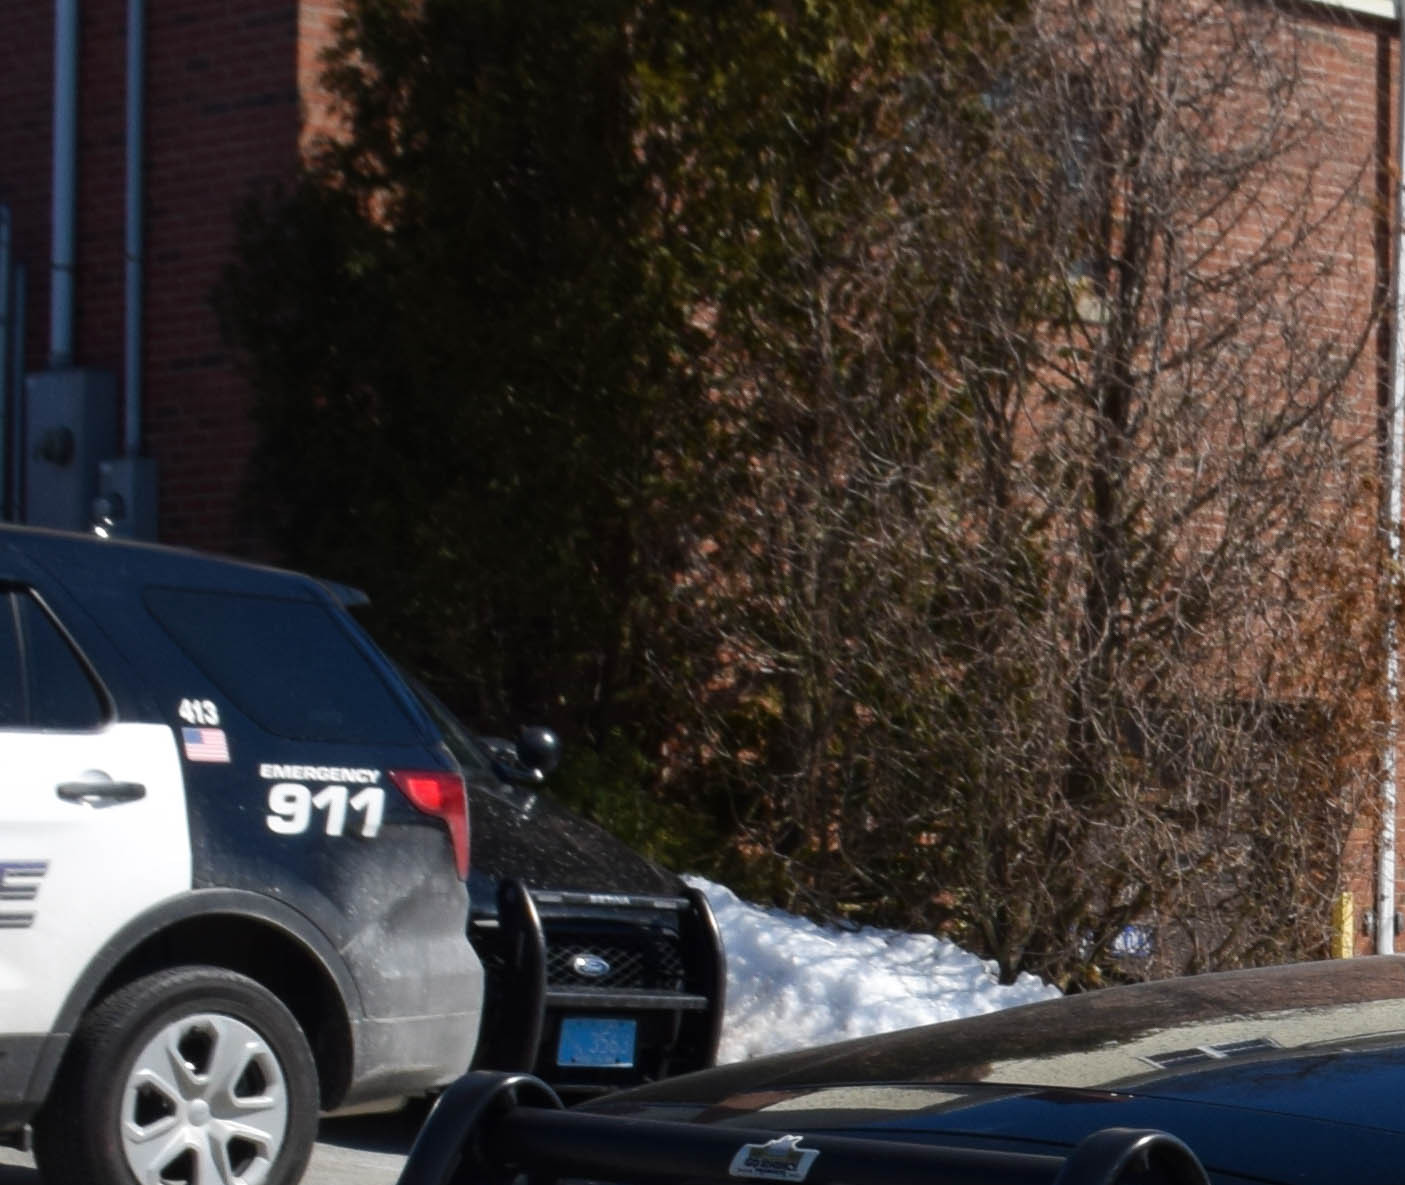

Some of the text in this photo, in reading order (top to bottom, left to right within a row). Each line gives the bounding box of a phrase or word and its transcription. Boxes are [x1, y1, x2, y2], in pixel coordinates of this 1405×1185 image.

[178, 698, 220, 726] 413
[258, 763, 381, 783] EMERGENCY
[266, 783, 386, 838] 911
